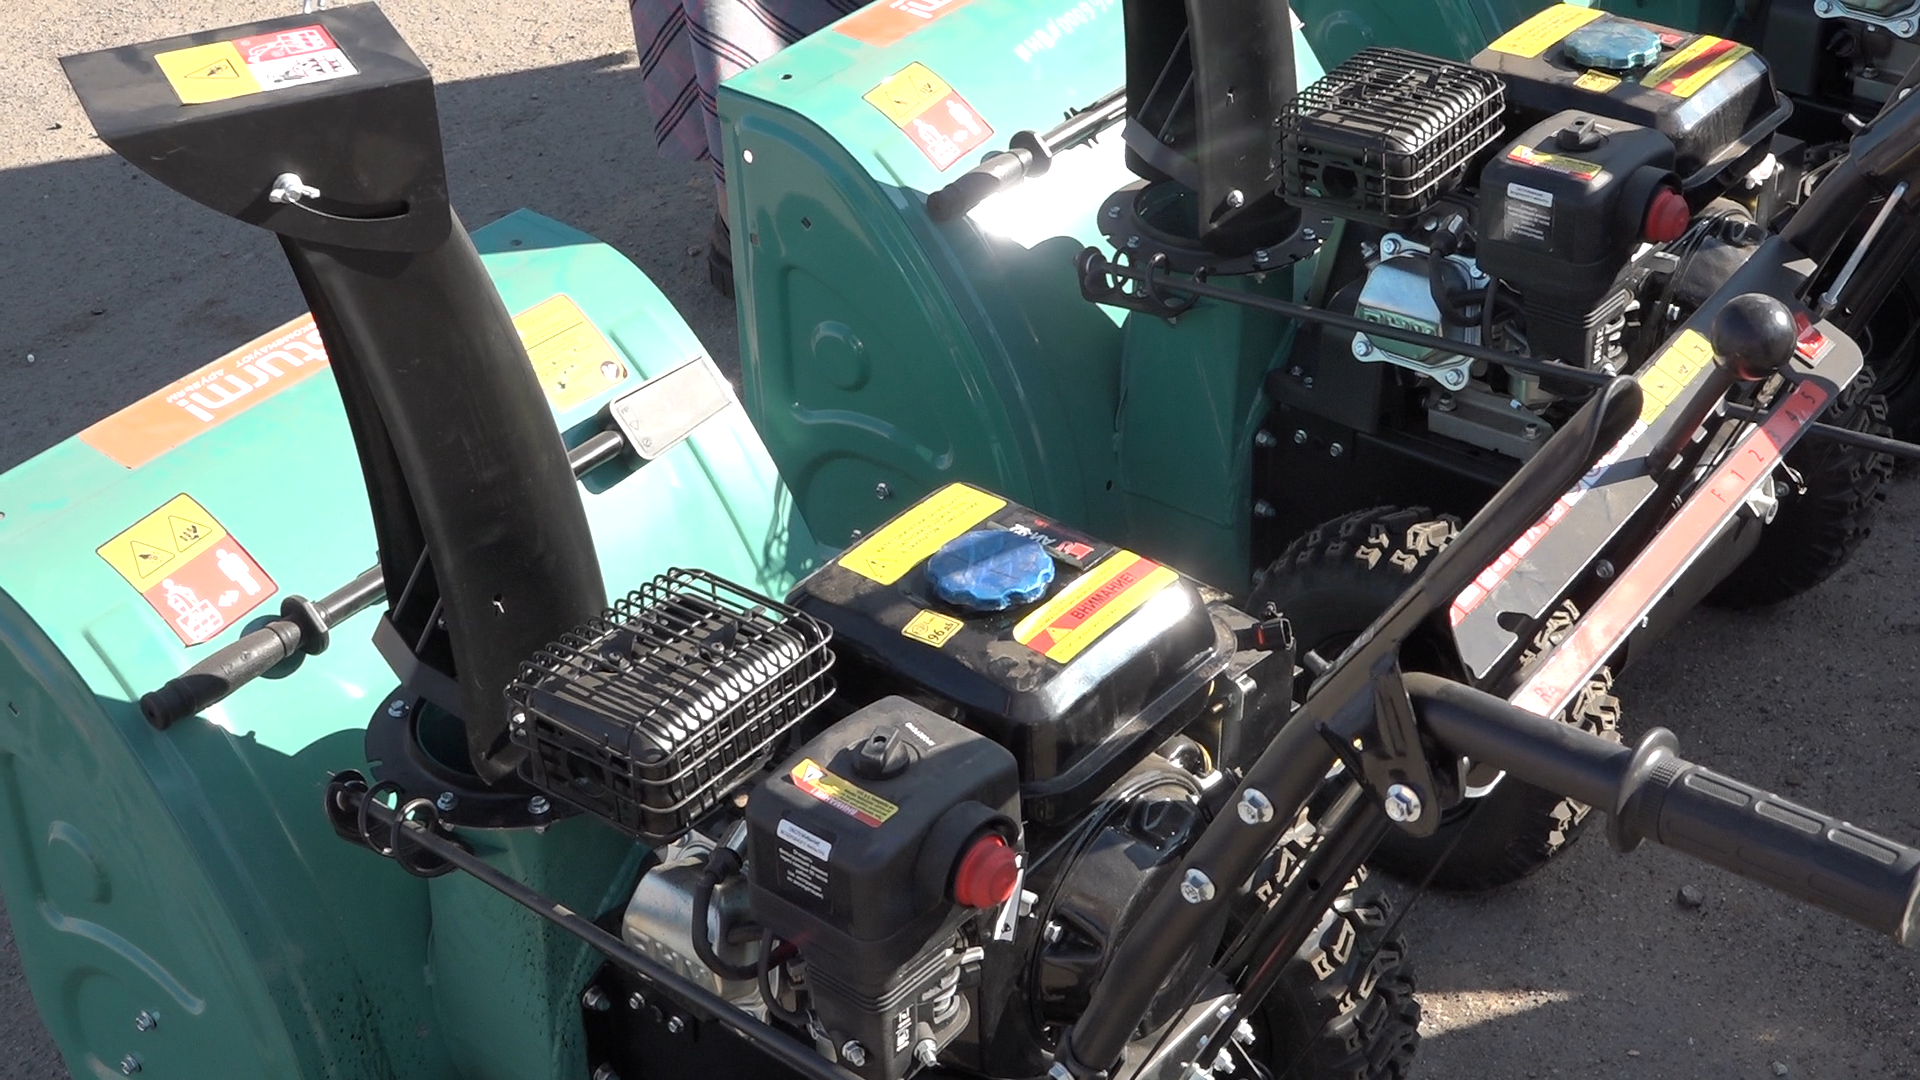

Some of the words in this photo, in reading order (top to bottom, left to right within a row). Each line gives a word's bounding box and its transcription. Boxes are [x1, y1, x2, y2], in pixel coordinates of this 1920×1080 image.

[236, 322, 317, 367] екомендуют
[1749, 450, 1764, 462] 2
[1785, 410, 1800, 423] 4
[1802, 392, 1816, 404] 5
[1072, 571, 1137, 619] ВНИМАНИЕ!
[927, 629, 945, 641] 96
